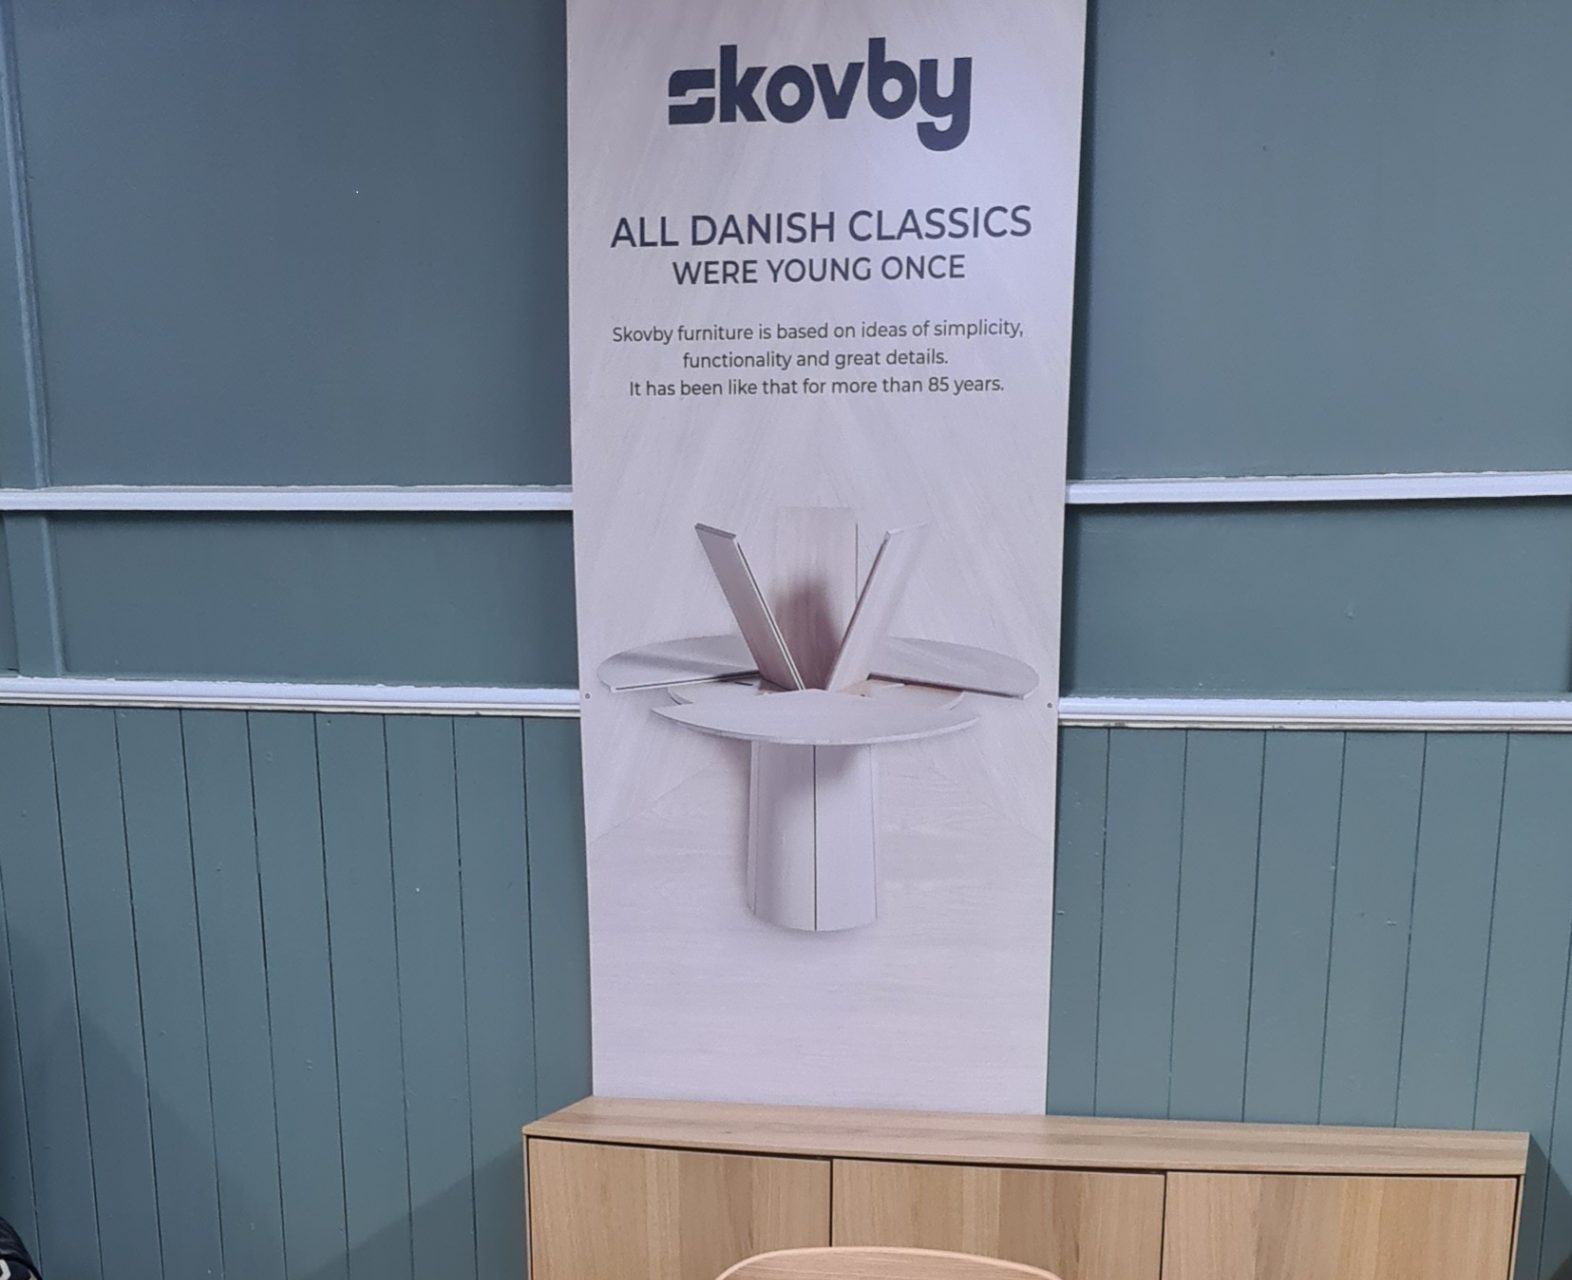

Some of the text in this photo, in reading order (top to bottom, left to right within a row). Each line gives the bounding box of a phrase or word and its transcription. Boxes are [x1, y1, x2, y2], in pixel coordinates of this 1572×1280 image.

[668, 37, 972, 151] skovby
[610, 205, 1031, 248] ALL DANISH CLASSICS
[672, 254, 965, 285] WERE YOUNG ONCE
[613, 318, 1023, 345] Skovby furniture is based on ideas of simplicity,
[683, 348, 948, 371] functionality and great details.
[630, 376, 1004, 396] It has been like that for more than 85 years.
